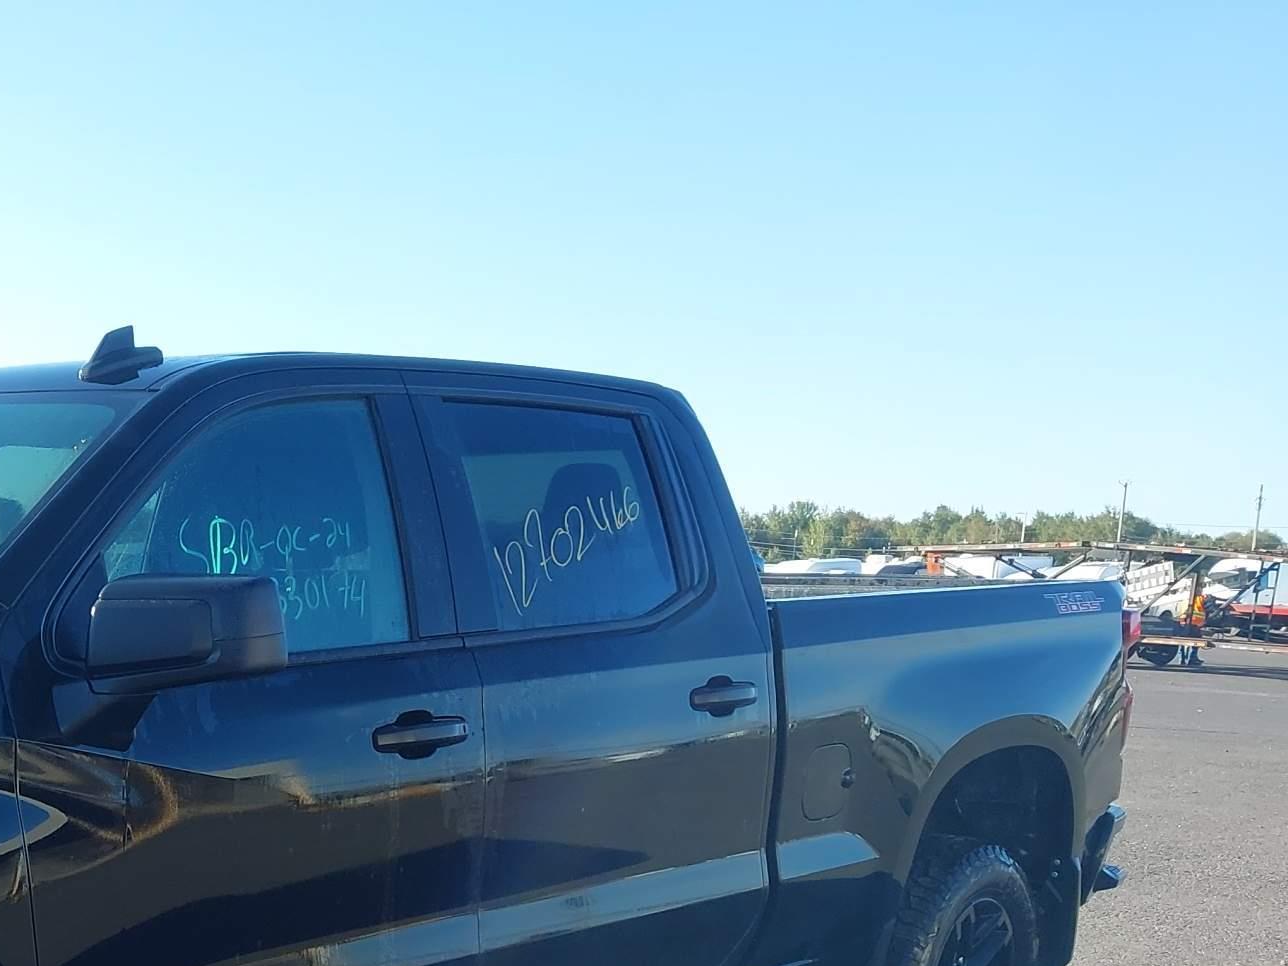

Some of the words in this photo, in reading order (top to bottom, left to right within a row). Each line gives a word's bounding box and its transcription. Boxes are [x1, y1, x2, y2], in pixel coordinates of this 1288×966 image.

[493, 485, 640, 617] 12702466
[1042, 590, 1105, 605] TRAIL
[1056, 601, 1102, 614] BOSS
